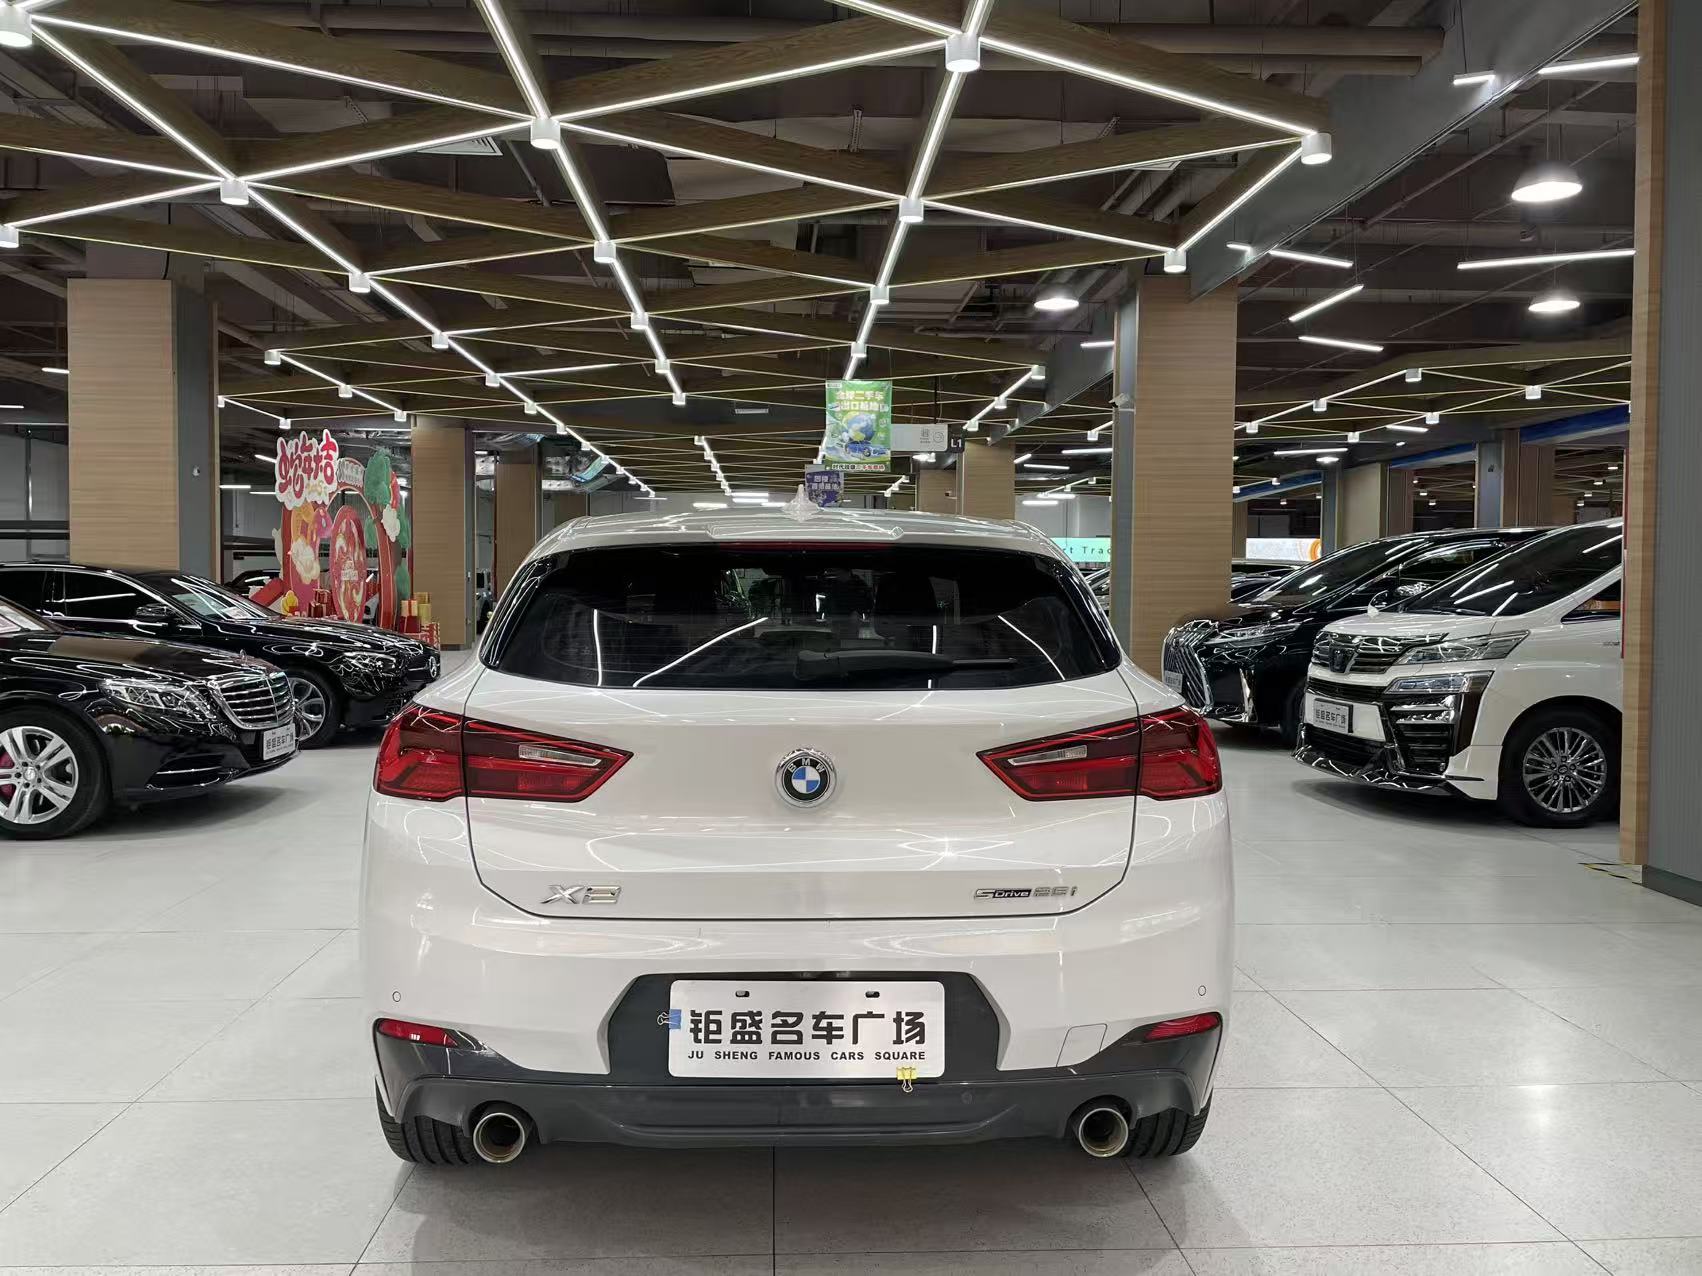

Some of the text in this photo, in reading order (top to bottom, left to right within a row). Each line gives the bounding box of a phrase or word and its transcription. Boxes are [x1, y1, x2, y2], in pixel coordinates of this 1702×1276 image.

[951, 438, 962, 448] L1
[787, 757, 825, 773] BMW
[541, 885, 621, 904] X2
[689, 1009, 926, 1045] 钜盛名车广场
[688, 1050, 926, 1061] JU SHENG FAMOUS CARS SQUARE
